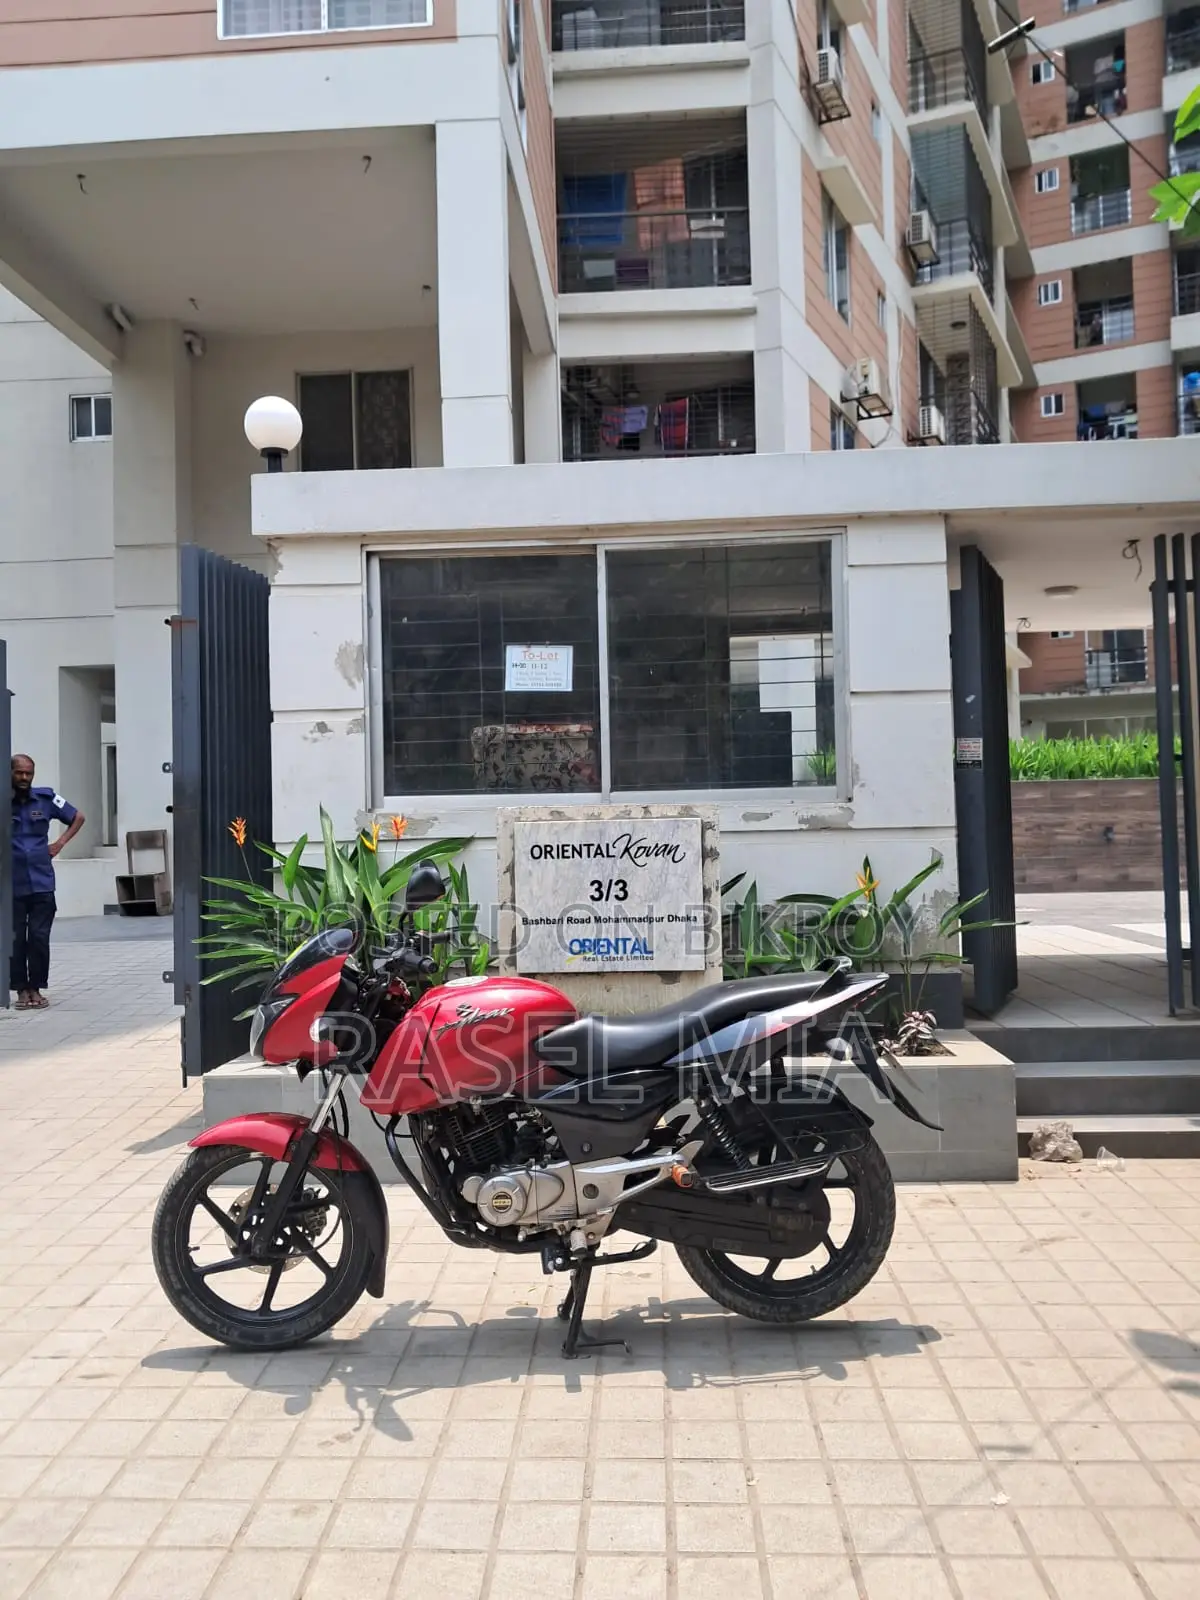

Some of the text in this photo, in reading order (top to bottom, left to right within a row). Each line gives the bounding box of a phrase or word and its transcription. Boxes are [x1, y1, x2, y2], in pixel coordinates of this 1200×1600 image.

[521, 650, 560, 660] To-Let
[530, 833, 686, 867] ORIENTAL Kovan
[589, 878, 629, 902] 3/3
[522, 913, 697, 926] Bashbari Road Mohammadpur Dhaka
[568, 937, 654, 955] ORIENTAL
[626, 954, 654, 962] Limited
